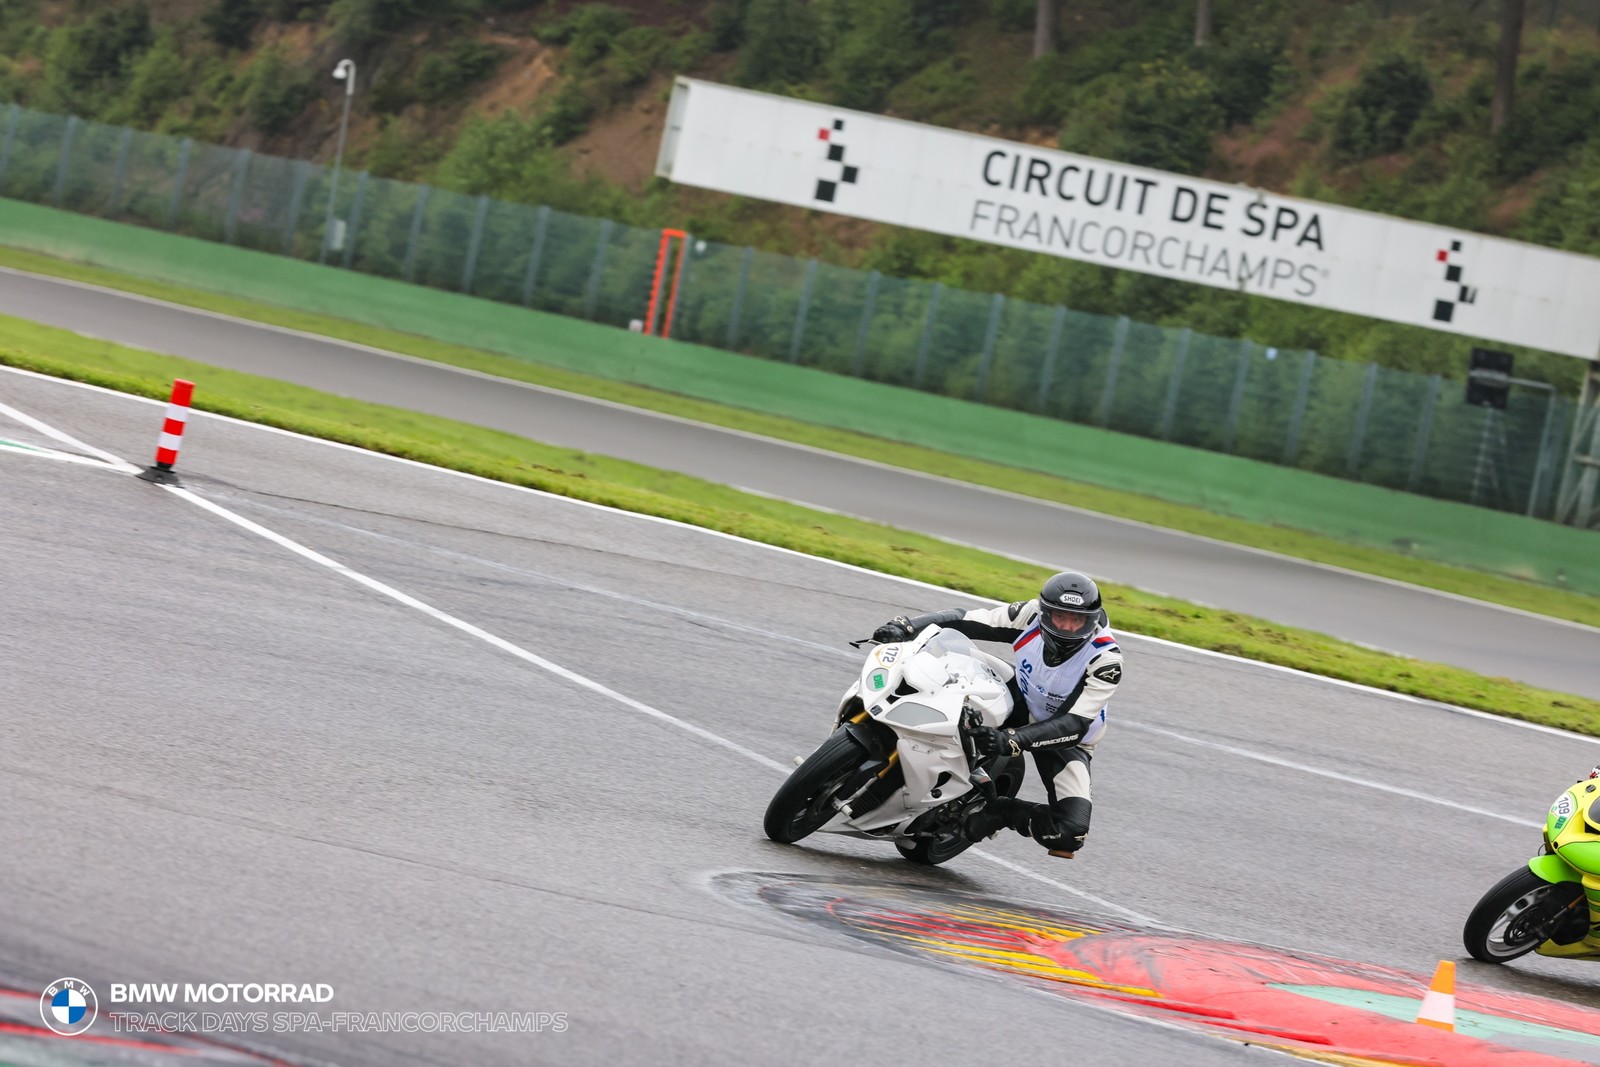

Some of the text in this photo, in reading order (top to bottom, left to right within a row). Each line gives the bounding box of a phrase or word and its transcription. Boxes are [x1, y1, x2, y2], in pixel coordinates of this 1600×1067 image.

[982, 149, 1325, 252] CIRCUIT DE SPA
[1063, 595, 1081, 604] SHOEI
[882, 646, 899, 663] 172
[1558, 797, 1570, 815] 109
